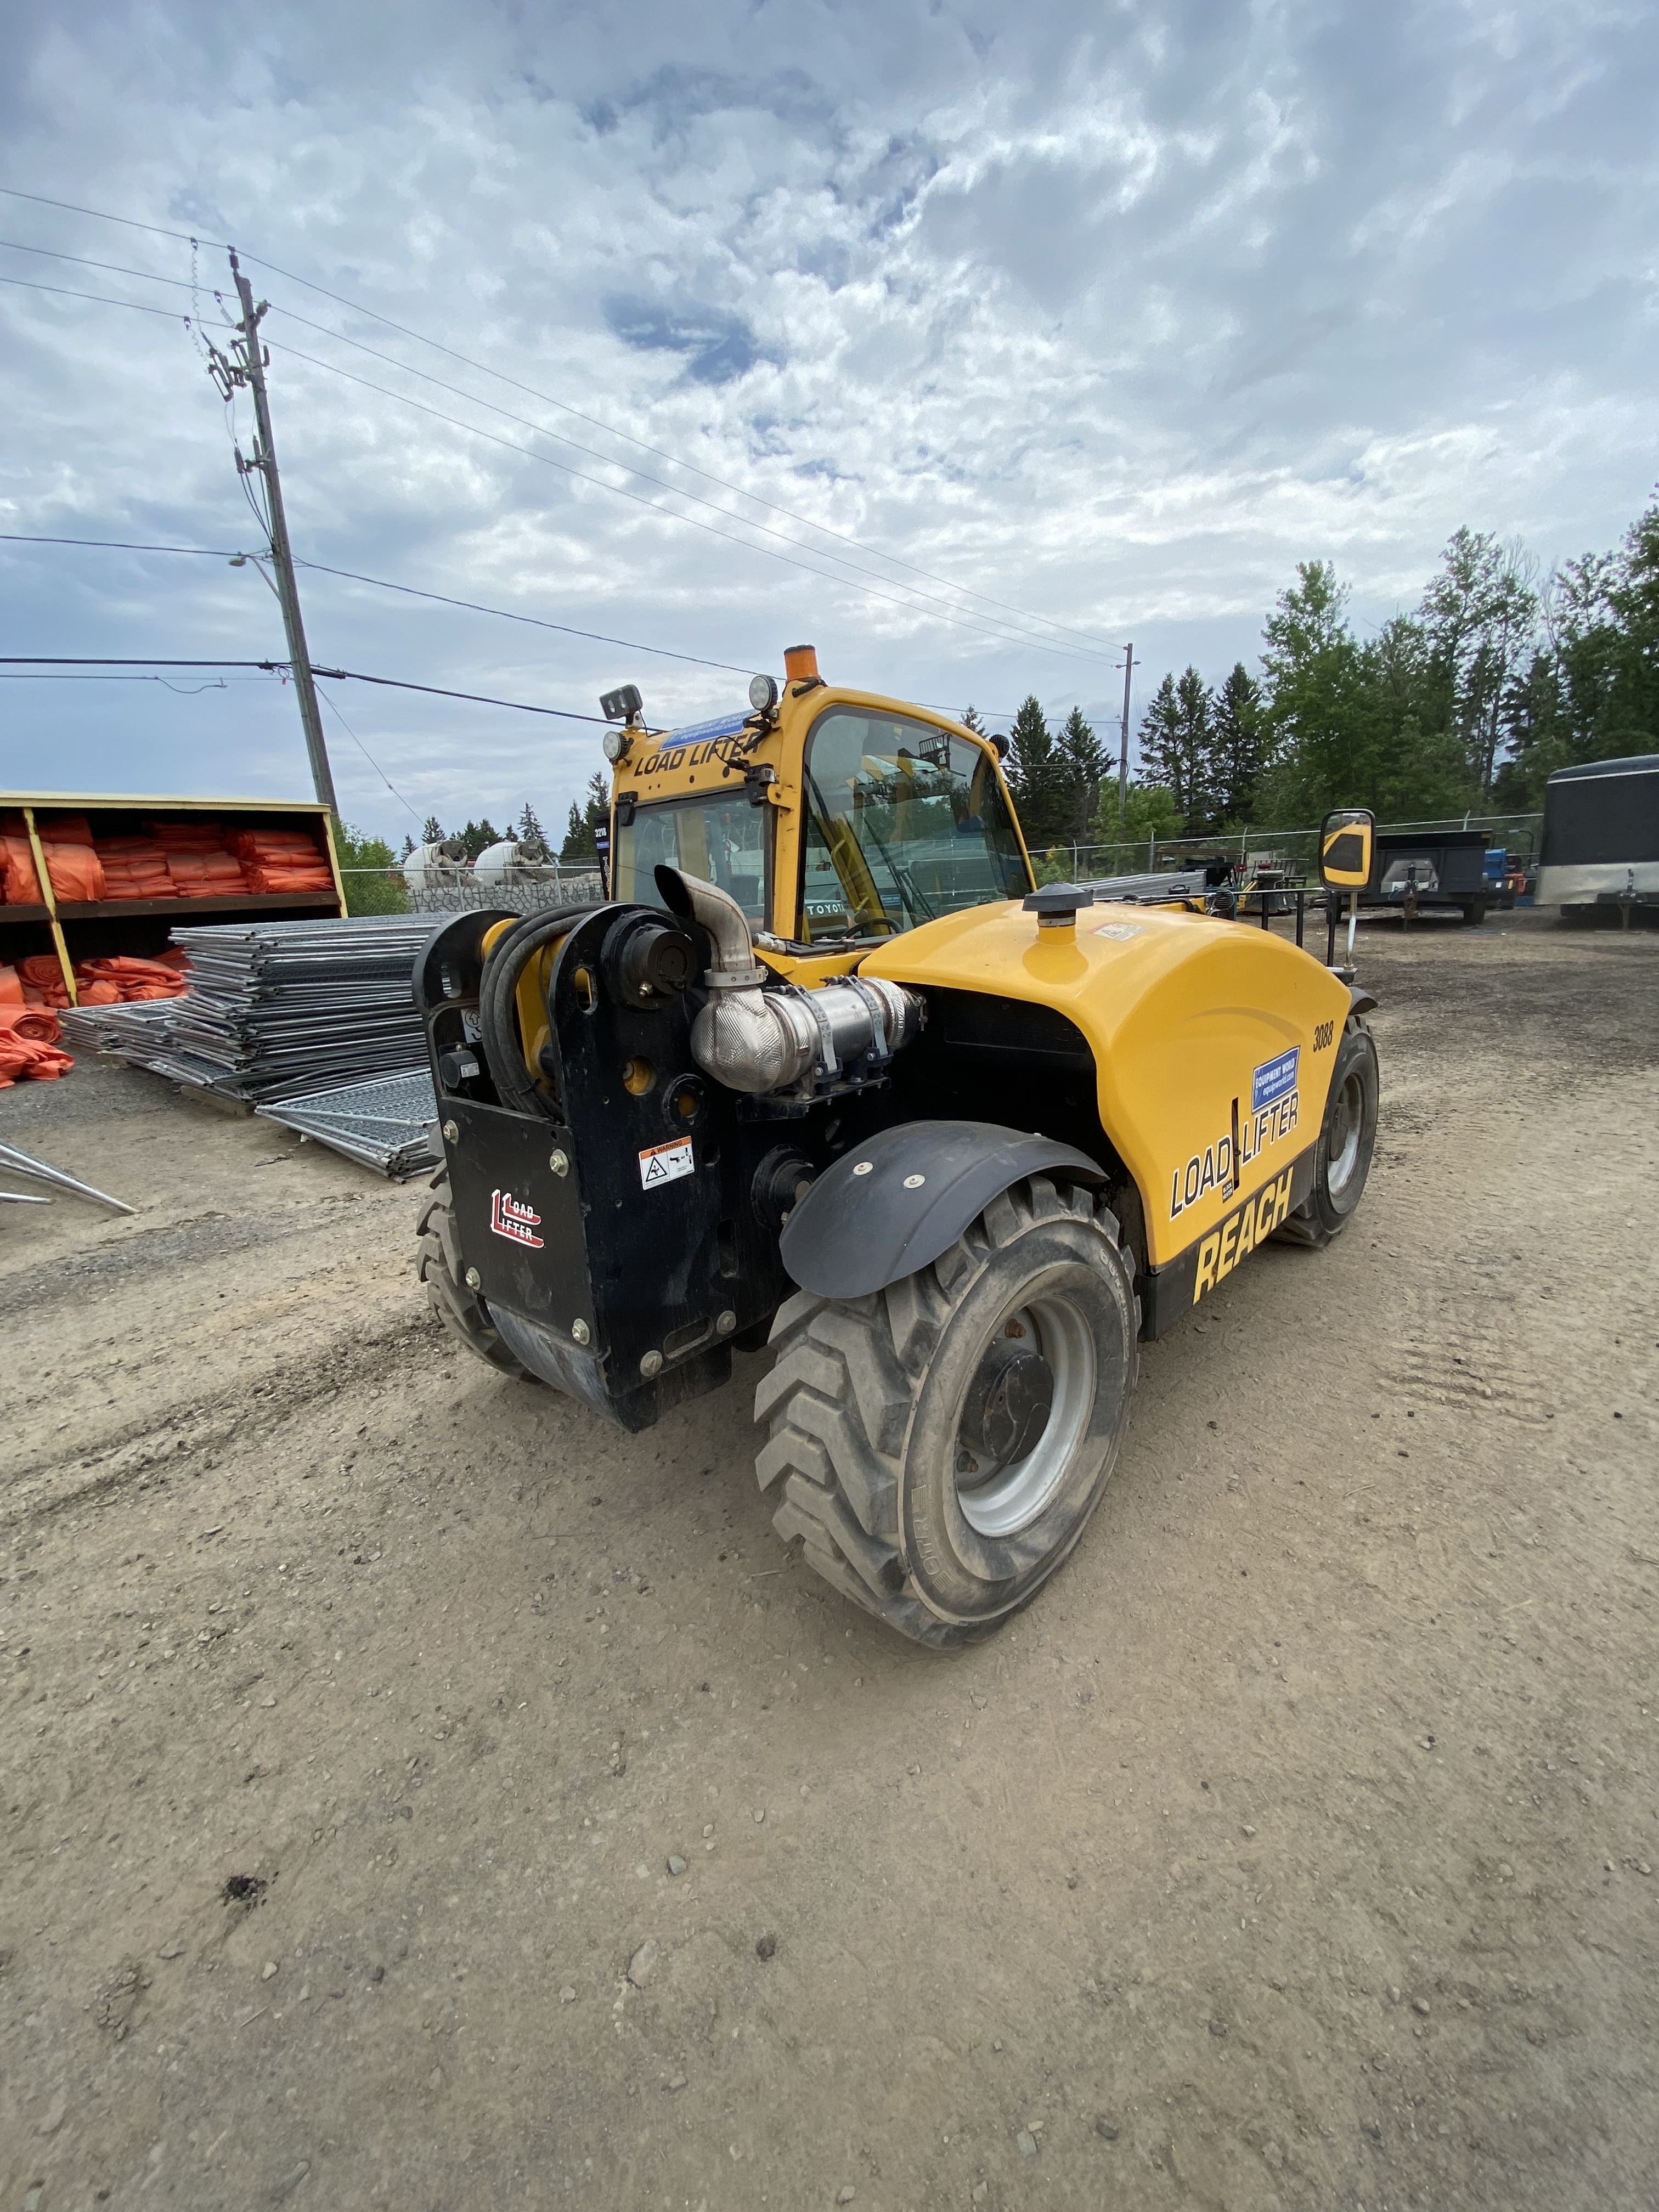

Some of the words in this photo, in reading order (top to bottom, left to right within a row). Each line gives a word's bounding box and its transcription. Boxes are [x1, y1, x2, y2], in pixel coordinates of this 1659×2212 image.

[634, 748, 686, 777] LOAD
[689, 730, 762, 766] LIFTER
[595, 827, 607, 838] 3218
[1313, 1019, 1334, 1053] 3088
[1255, 1066, 1282, 1089] EQUIPMENT
[1282, 1057, 1295, 1074] WORLD
[1262, 1071, 1295, 1096] equipworld.com
[657, 1141, 682, 1153] WARNING
[1169, 1133, 1232, 1223] LOAD
[1240, 1089, 1300, 1167] LIFTER
[490, 1188, 545, 1248] LIFTER
[502, 1192, 541, 1226] LOAD
[1193, 1166, 1294, 1306] REACH
[913, 1517, 940, 1576] OTR
